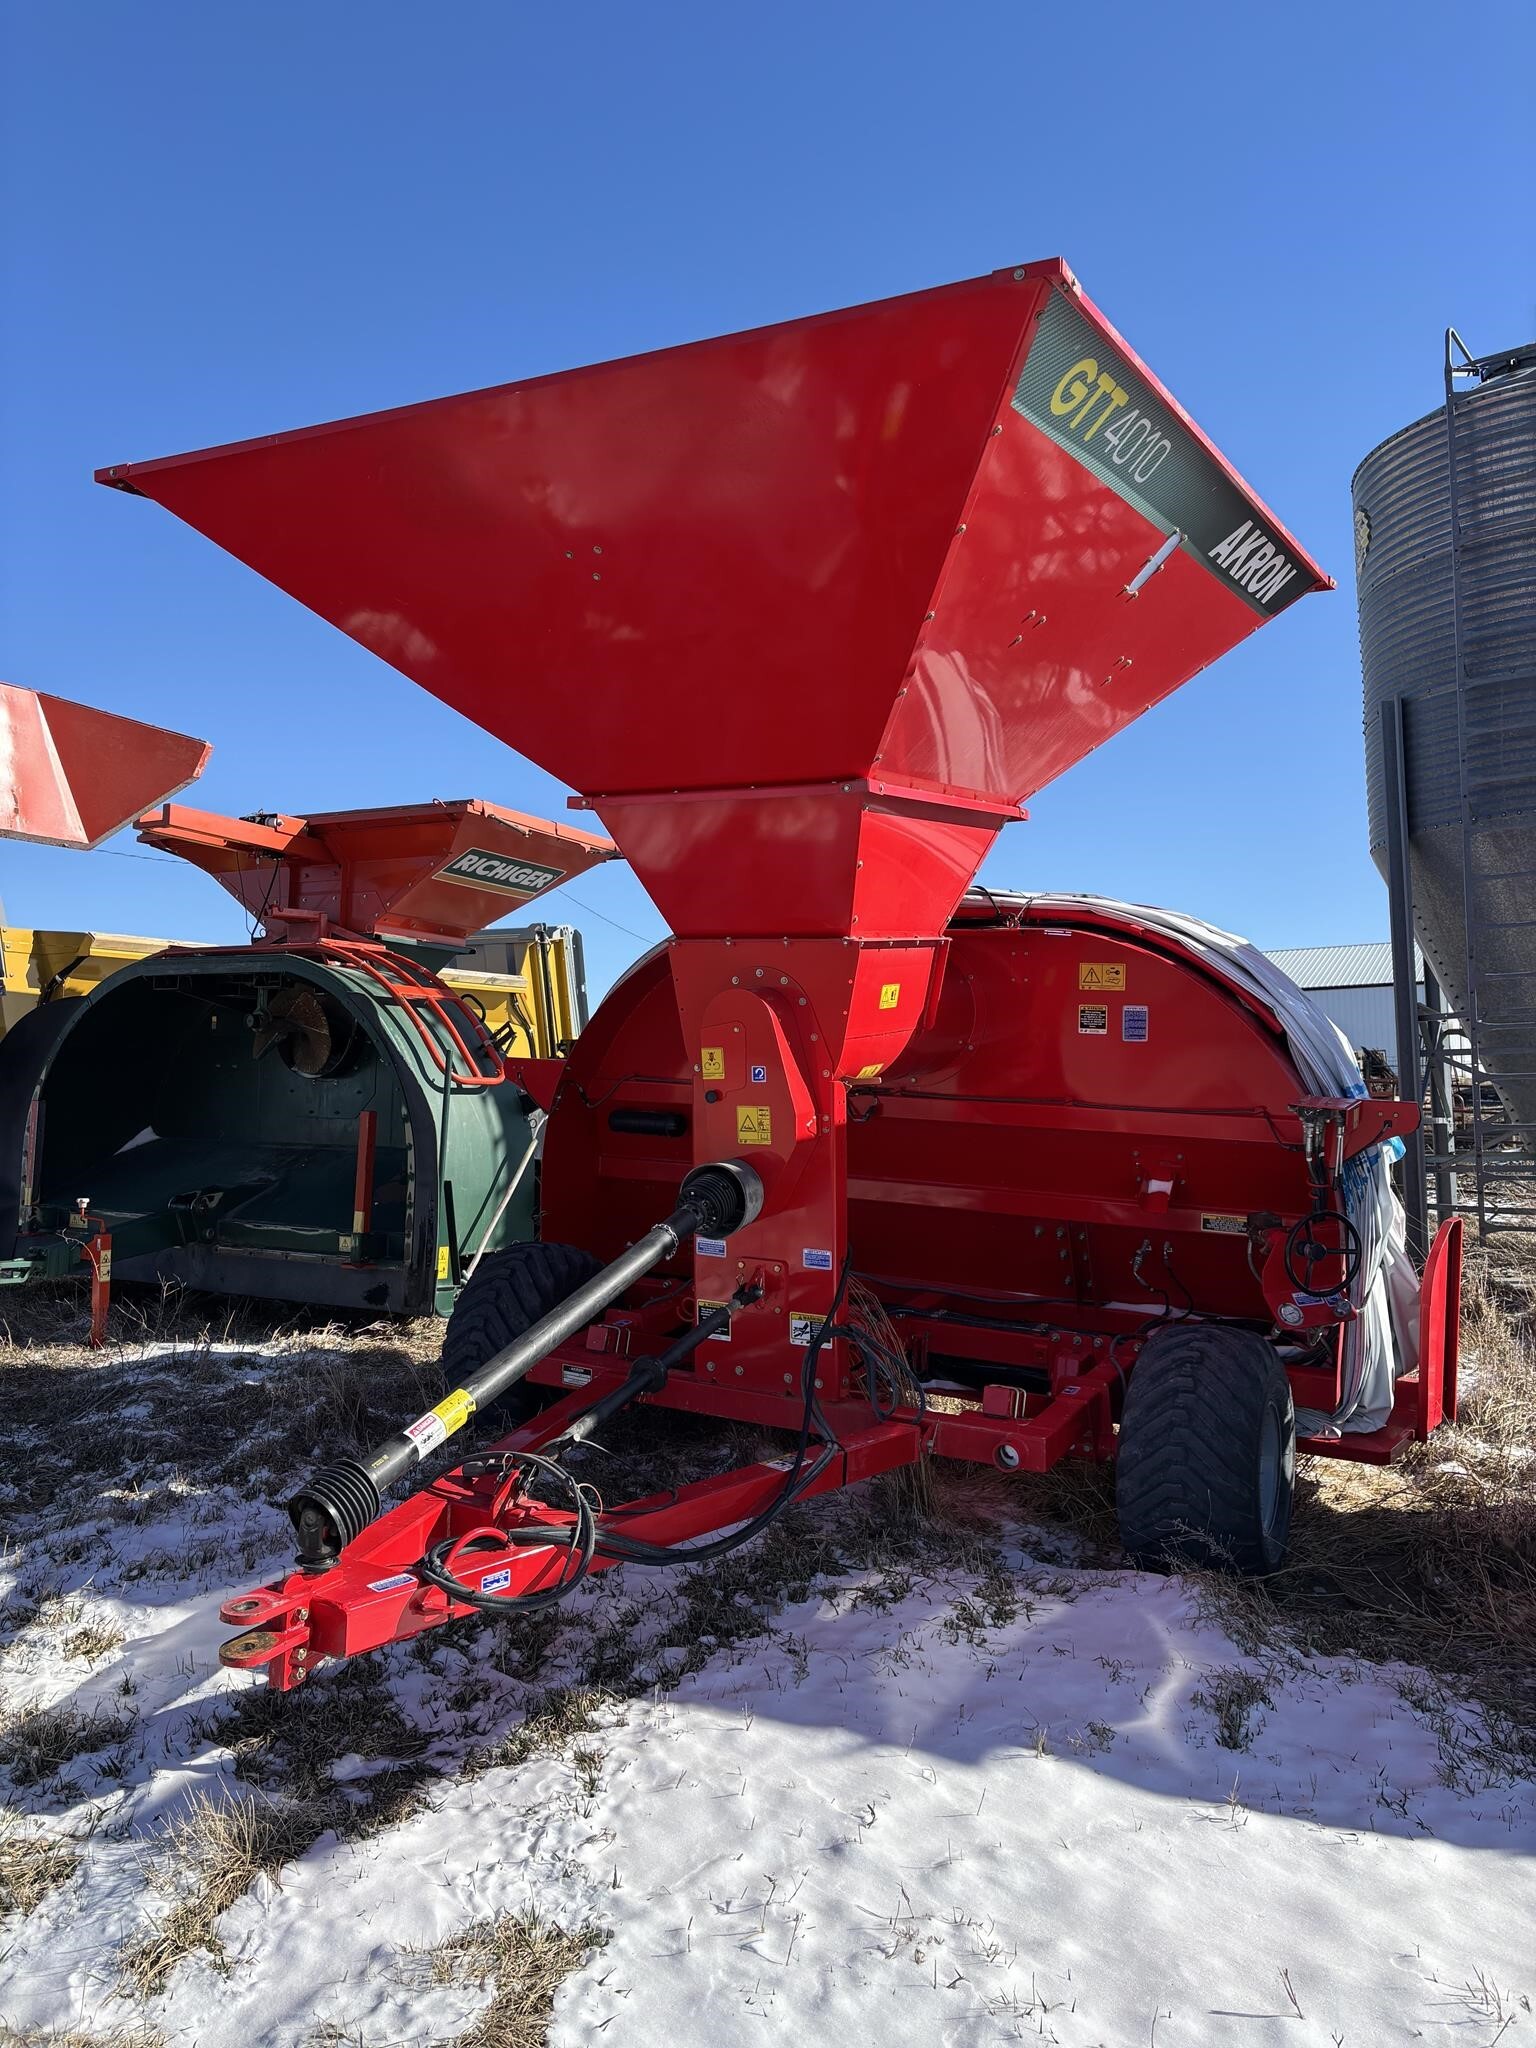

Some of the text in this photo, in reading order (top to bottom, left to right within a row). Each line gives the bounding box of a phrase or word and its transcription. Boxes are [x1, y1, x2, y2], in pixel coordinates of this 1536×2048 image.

[1050, 358, 1172, 483] GTT 4010
[1208, 519, 1298, 604] AKRON
[453, 854, 553, 888] RICHIGER
